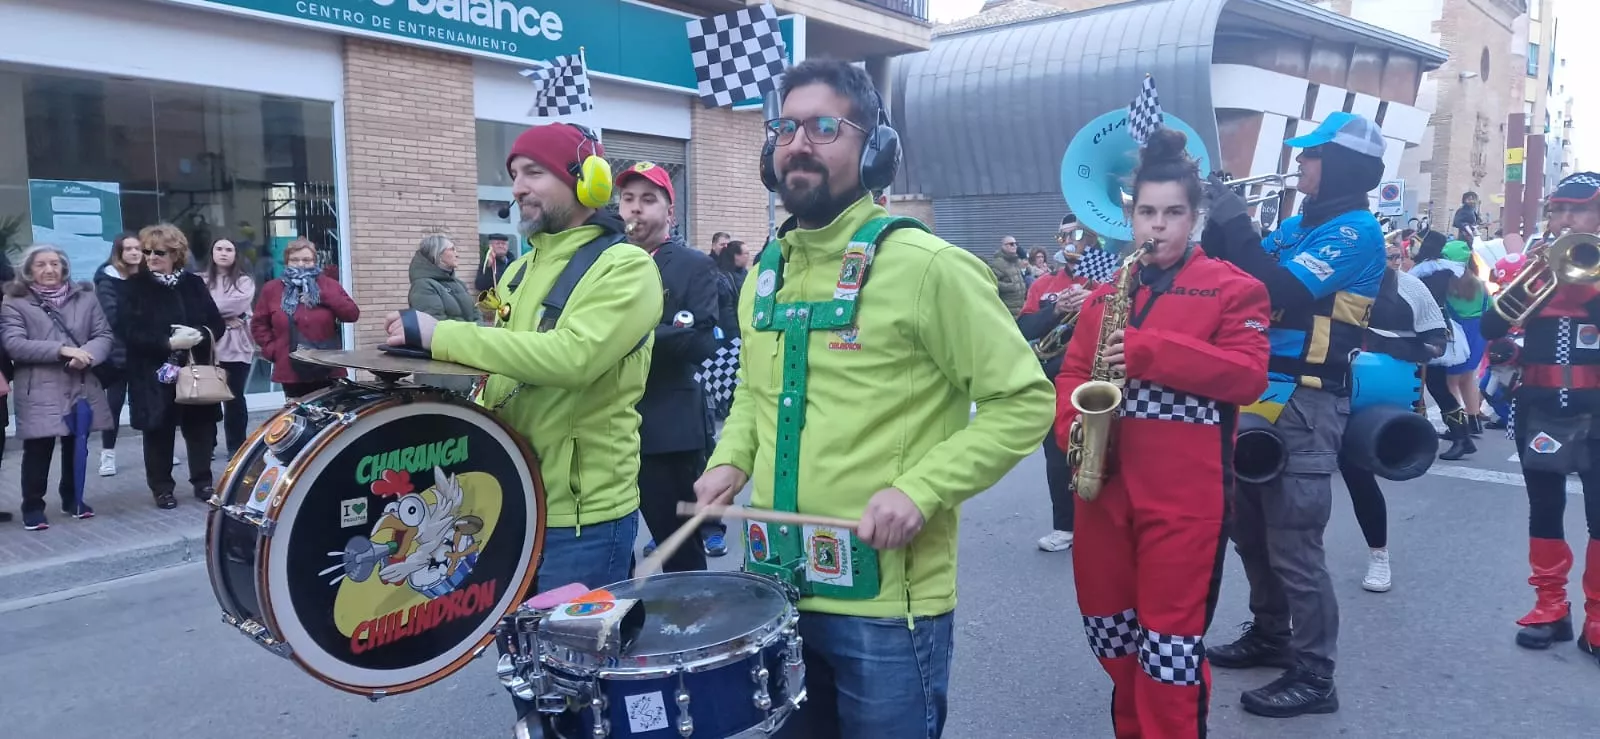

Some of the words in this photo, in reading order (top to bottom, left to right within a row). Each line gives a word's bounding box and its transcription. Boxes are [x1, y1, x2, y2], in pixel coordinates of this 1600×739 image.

[296, 2, 364, 24] CENTRO
[371, 15, 391, 29] DE
[398, 20, 518, 52] ENTRENAMIENTO
[1092, 117, 1127, 145] CHA
[1086, 200, 1133, 229] CHILIN
[1162, 286, 1220, 298] acer
[356, 435, 469, 485] CHARANGA
[351, 578, 497, 654] CHILINDRON
